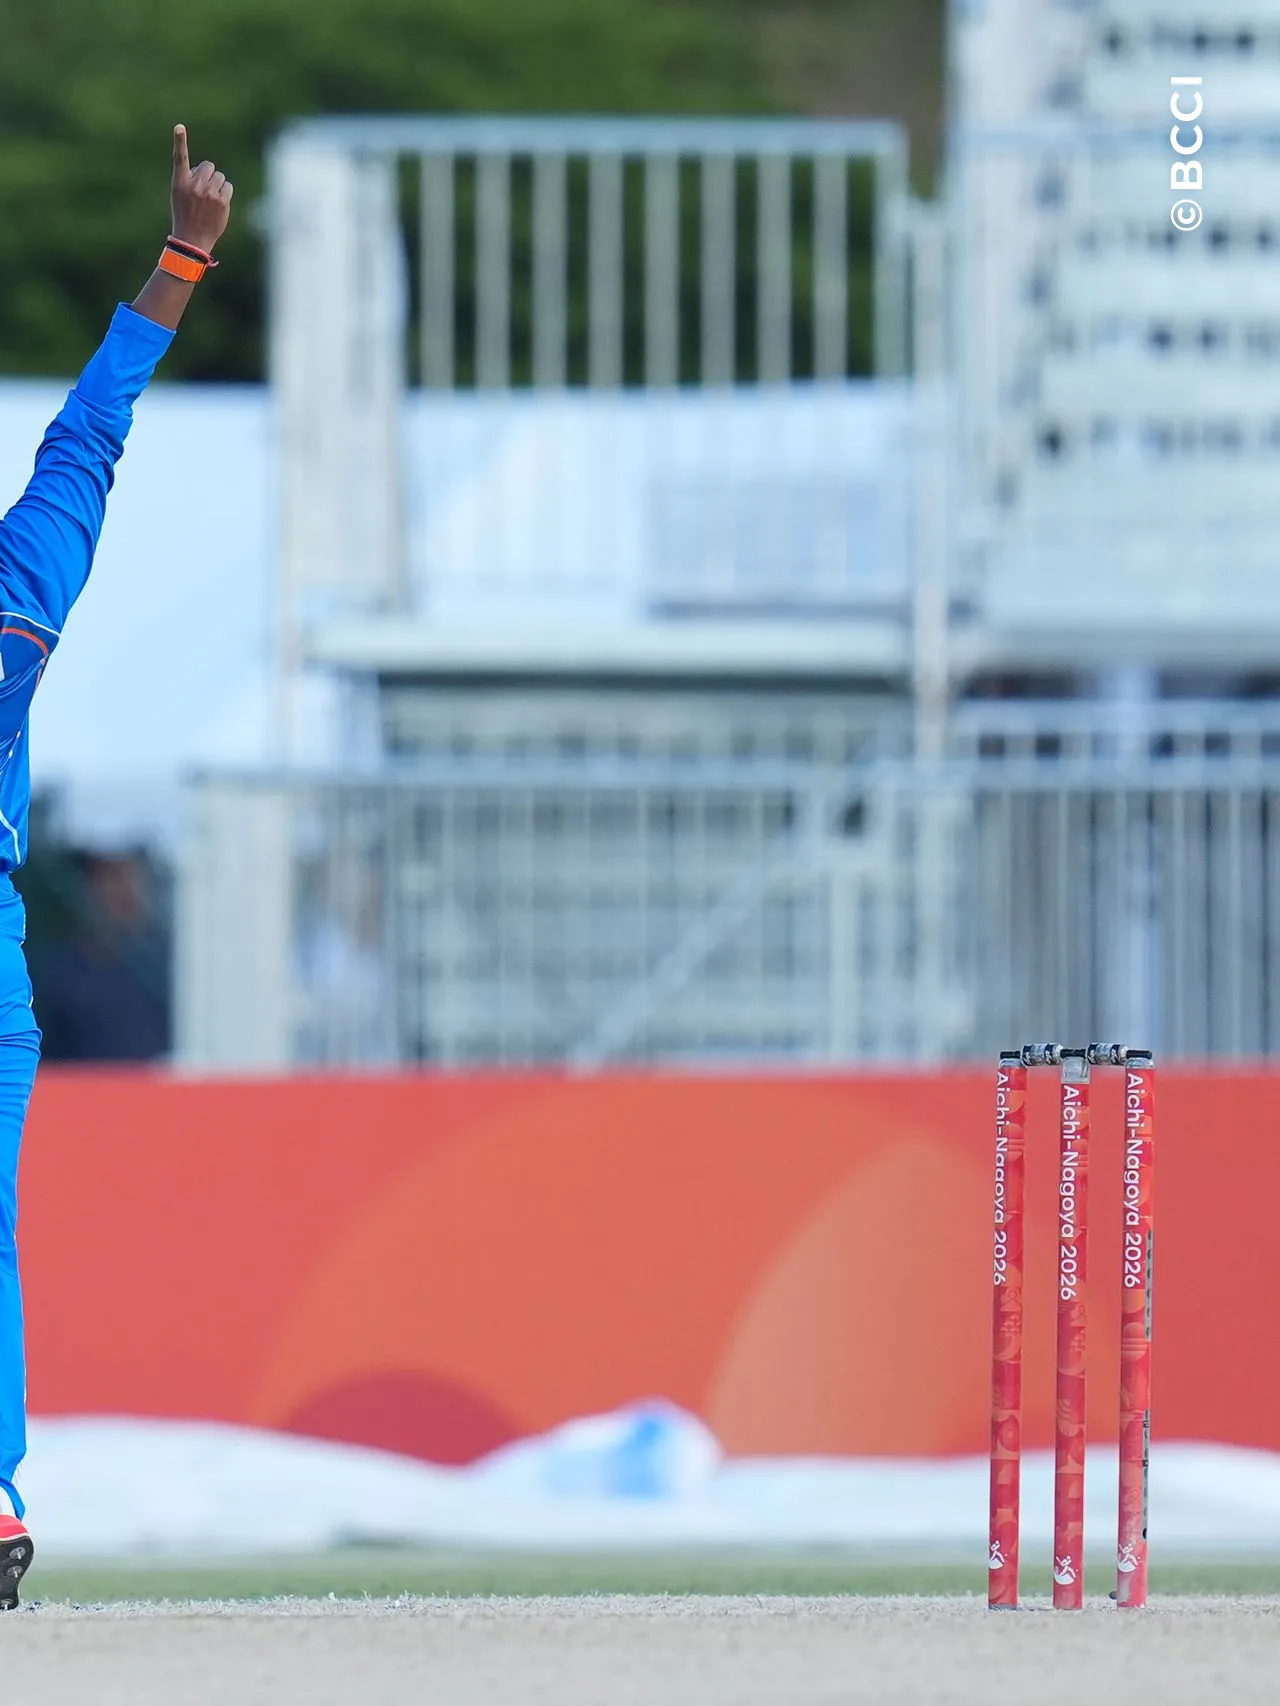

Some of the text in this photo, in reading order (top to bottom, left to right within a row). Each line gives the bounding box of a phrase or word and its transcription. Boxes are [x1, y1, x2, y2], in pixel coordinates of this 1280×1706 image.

[993, 1071, 1012, 1286] Aichi-Nagoya 2026
[1059, 1084, 1082, 1300] Aichi-Nagoya 2026
[1123, 1072, 1146, 1288] Aichi-Nagoya 2026
